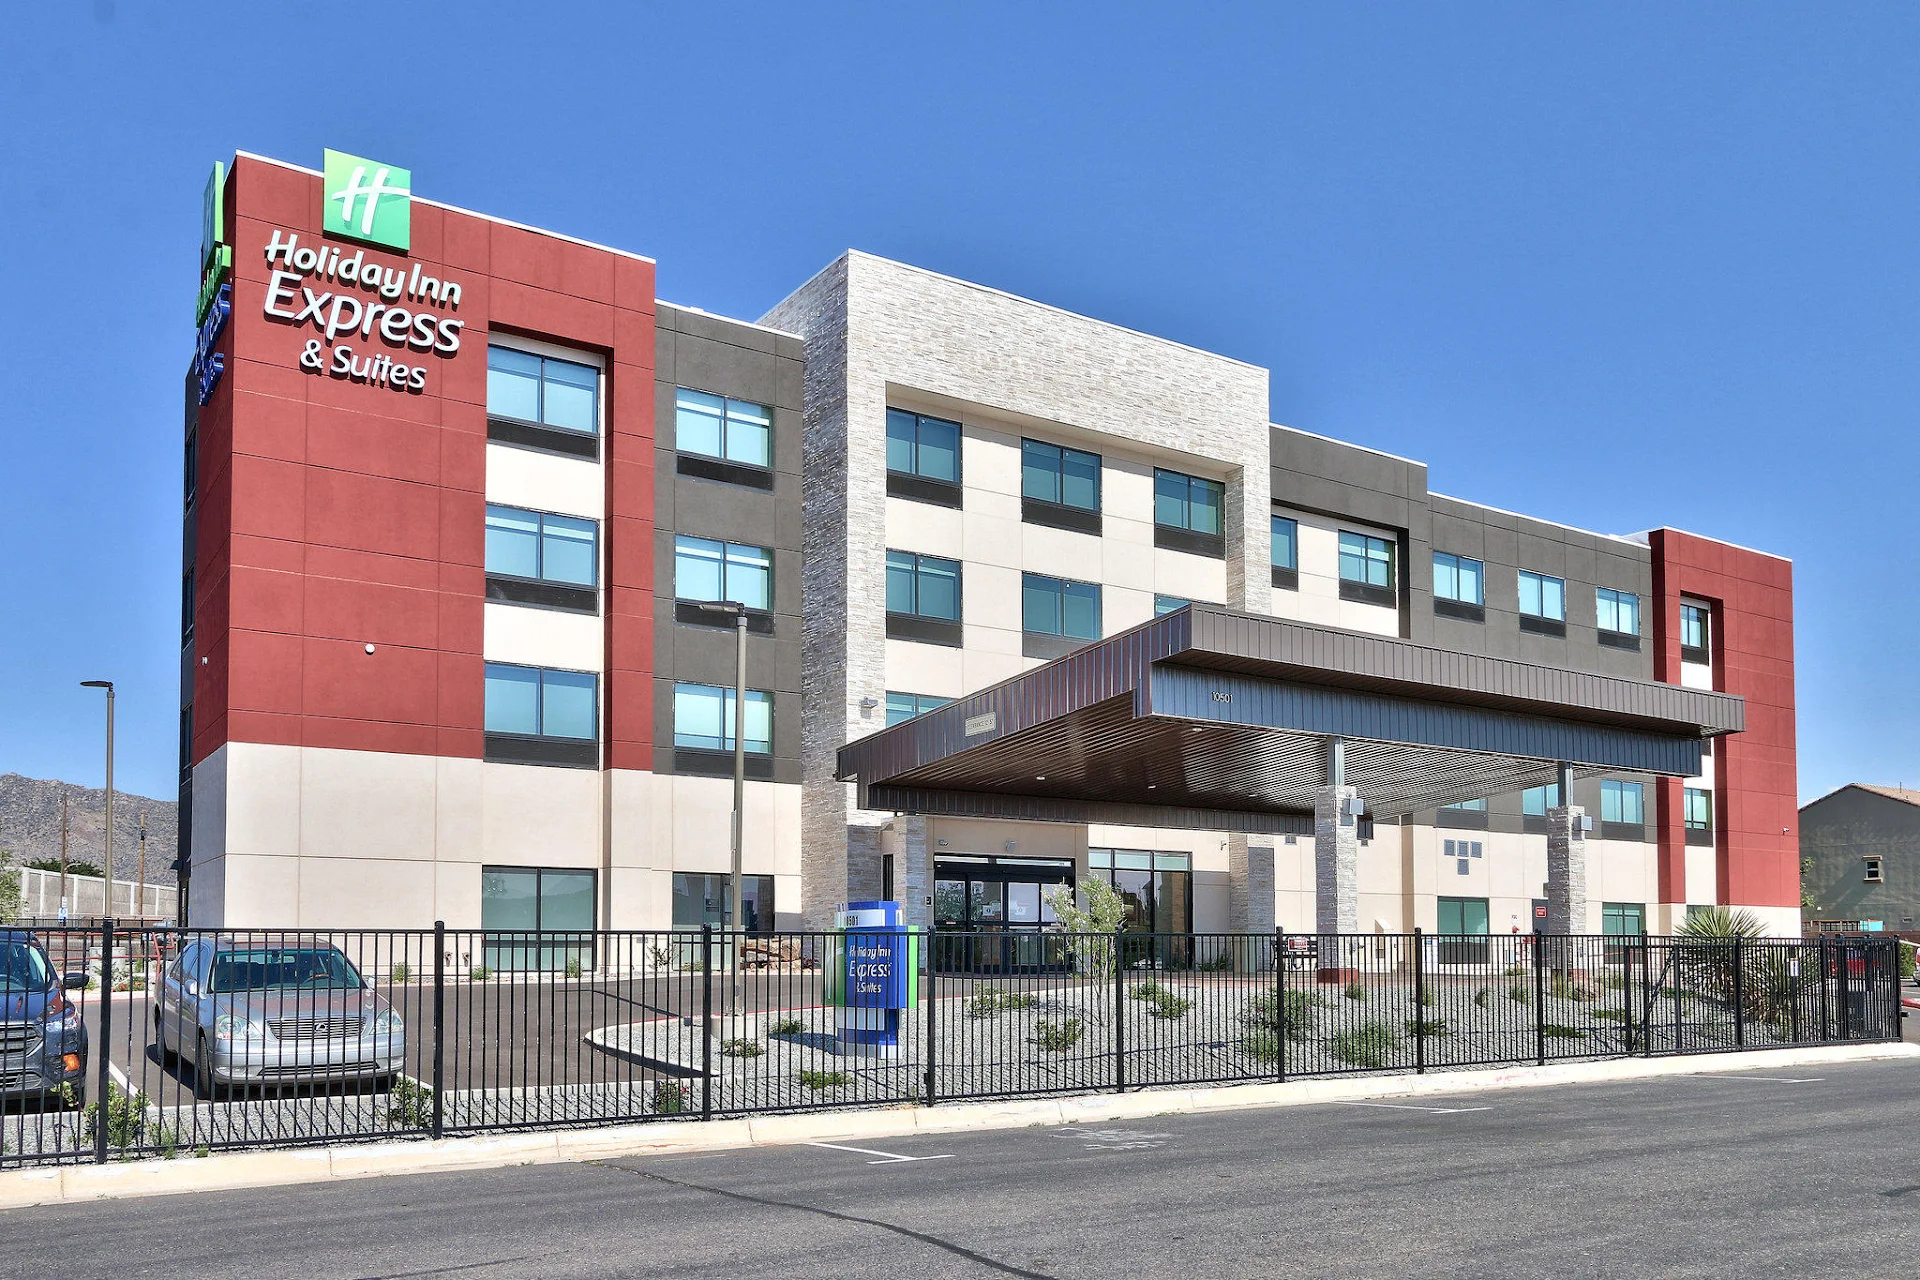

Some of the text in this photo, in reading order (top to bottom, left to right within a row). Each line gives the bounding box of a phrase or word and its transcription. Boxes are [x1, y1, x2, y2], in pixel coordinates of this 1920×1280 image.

[264, 229, 406, 298] Holiday
[408, 262, 462, 305] Inn
[264, 269, 464, 352] Express
[300, 339, 428, 389] & Suites
[1212, 691, 1234, 704] 10501
